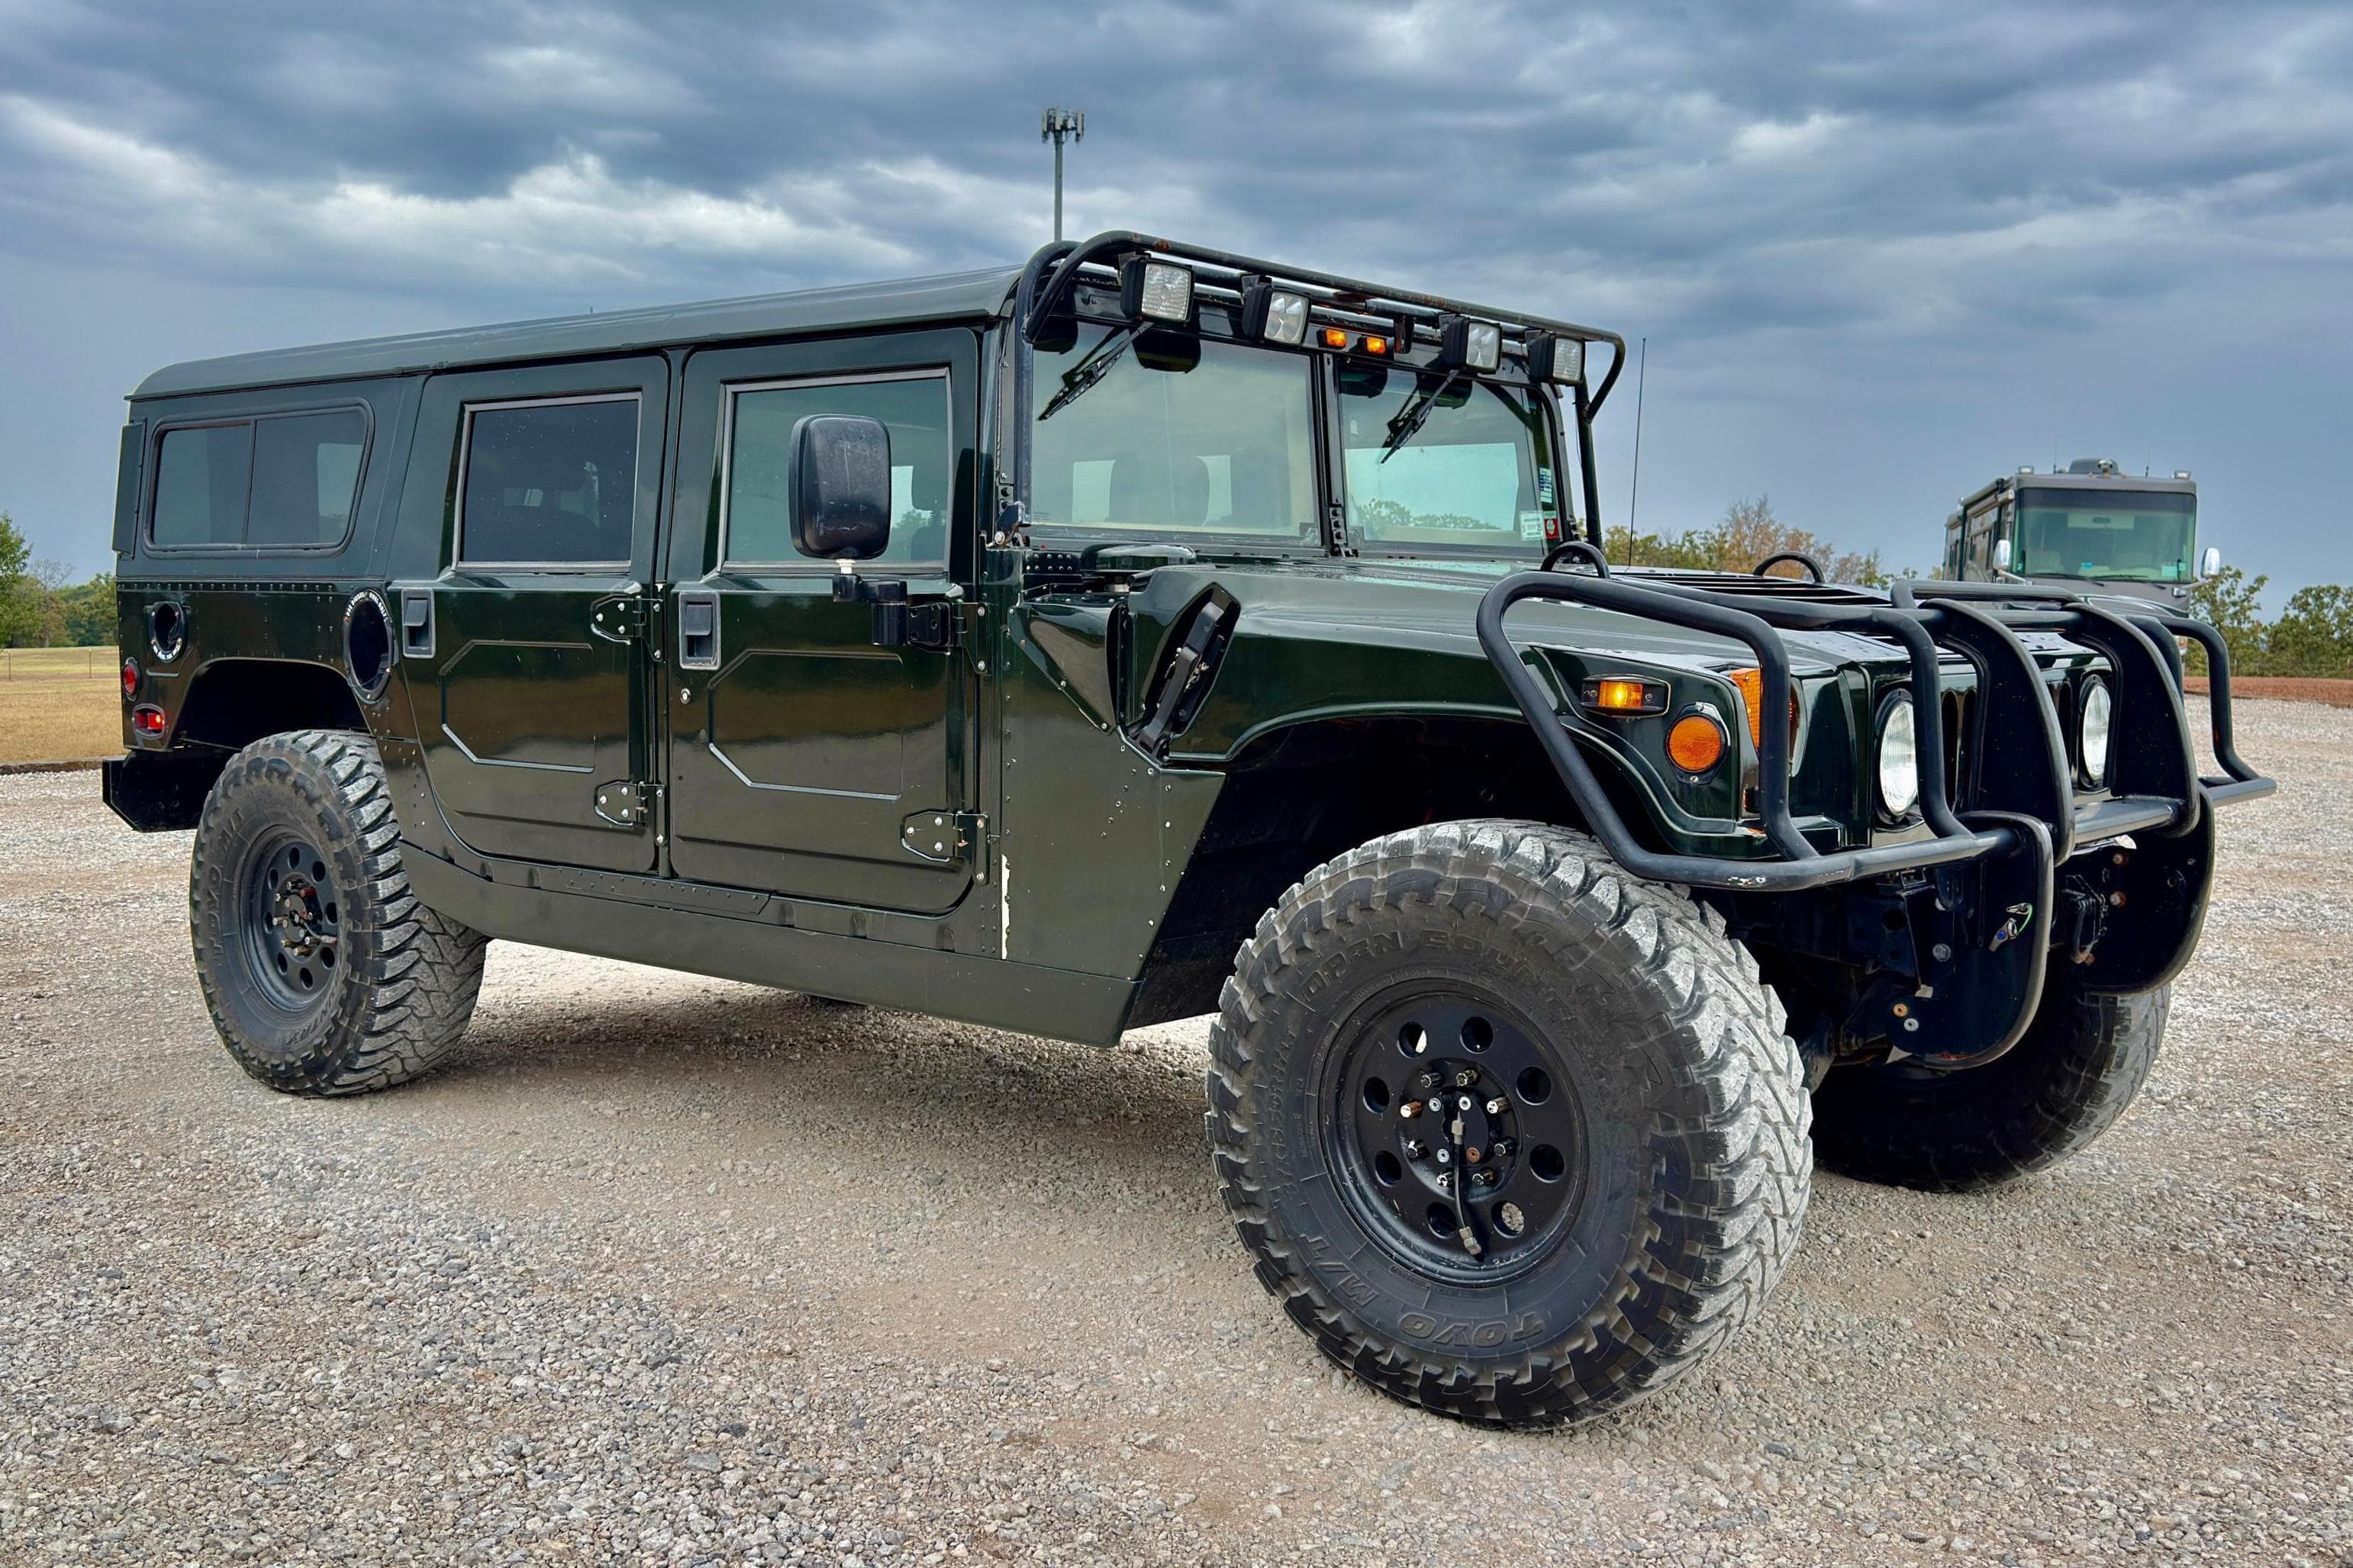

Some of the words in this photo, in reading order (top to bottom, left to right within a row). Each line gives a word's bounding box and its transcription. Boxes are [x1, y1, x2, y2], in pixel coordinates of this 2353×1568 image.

[207, 864, 223, 964] TOYO
[1301, 929, 1403, 1001] OPEN
[1299, 1233, 1381, 1307] M/T
[1397, 1311, 1546, 1348] TOYO
